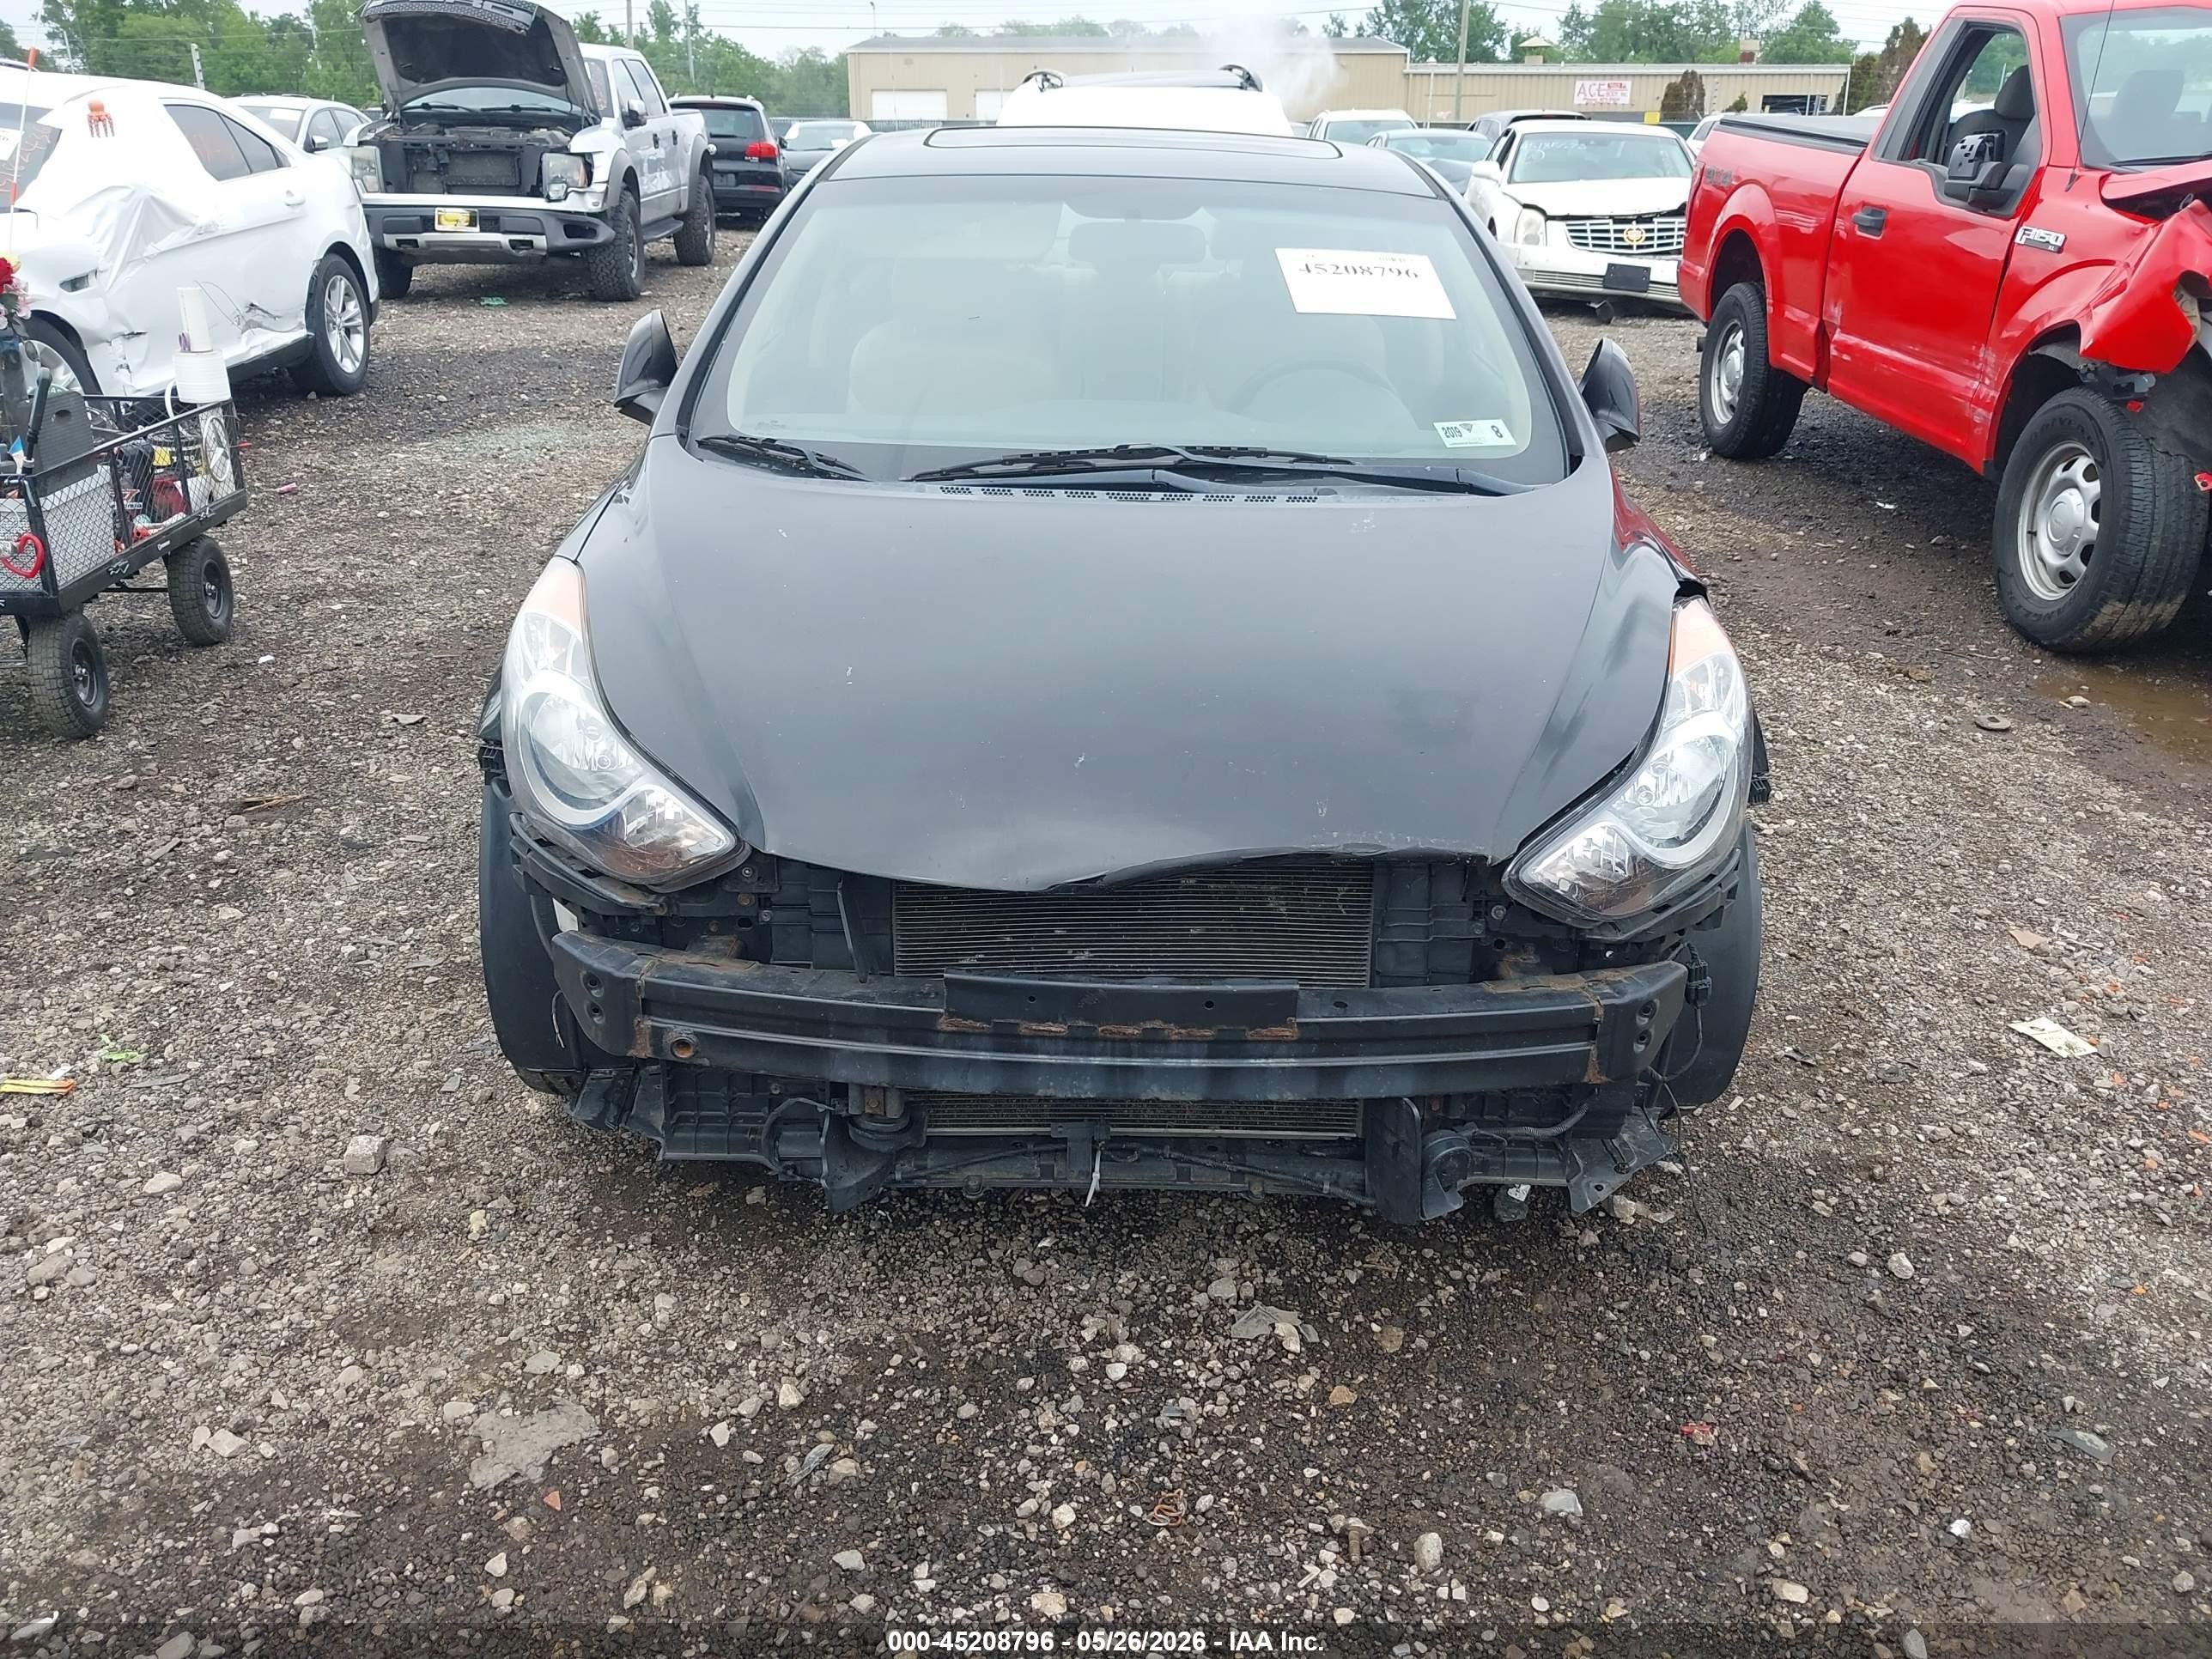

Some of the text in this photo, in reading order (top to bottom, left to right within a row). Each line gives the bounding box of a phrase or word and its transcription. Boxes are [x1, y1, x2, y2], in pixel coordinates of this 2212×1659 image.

[1577, 82, 1606, 97] ACE
[1298, 263, 1419, 279] 45208796
[1441, 424, 1504, 439] 2019 8
